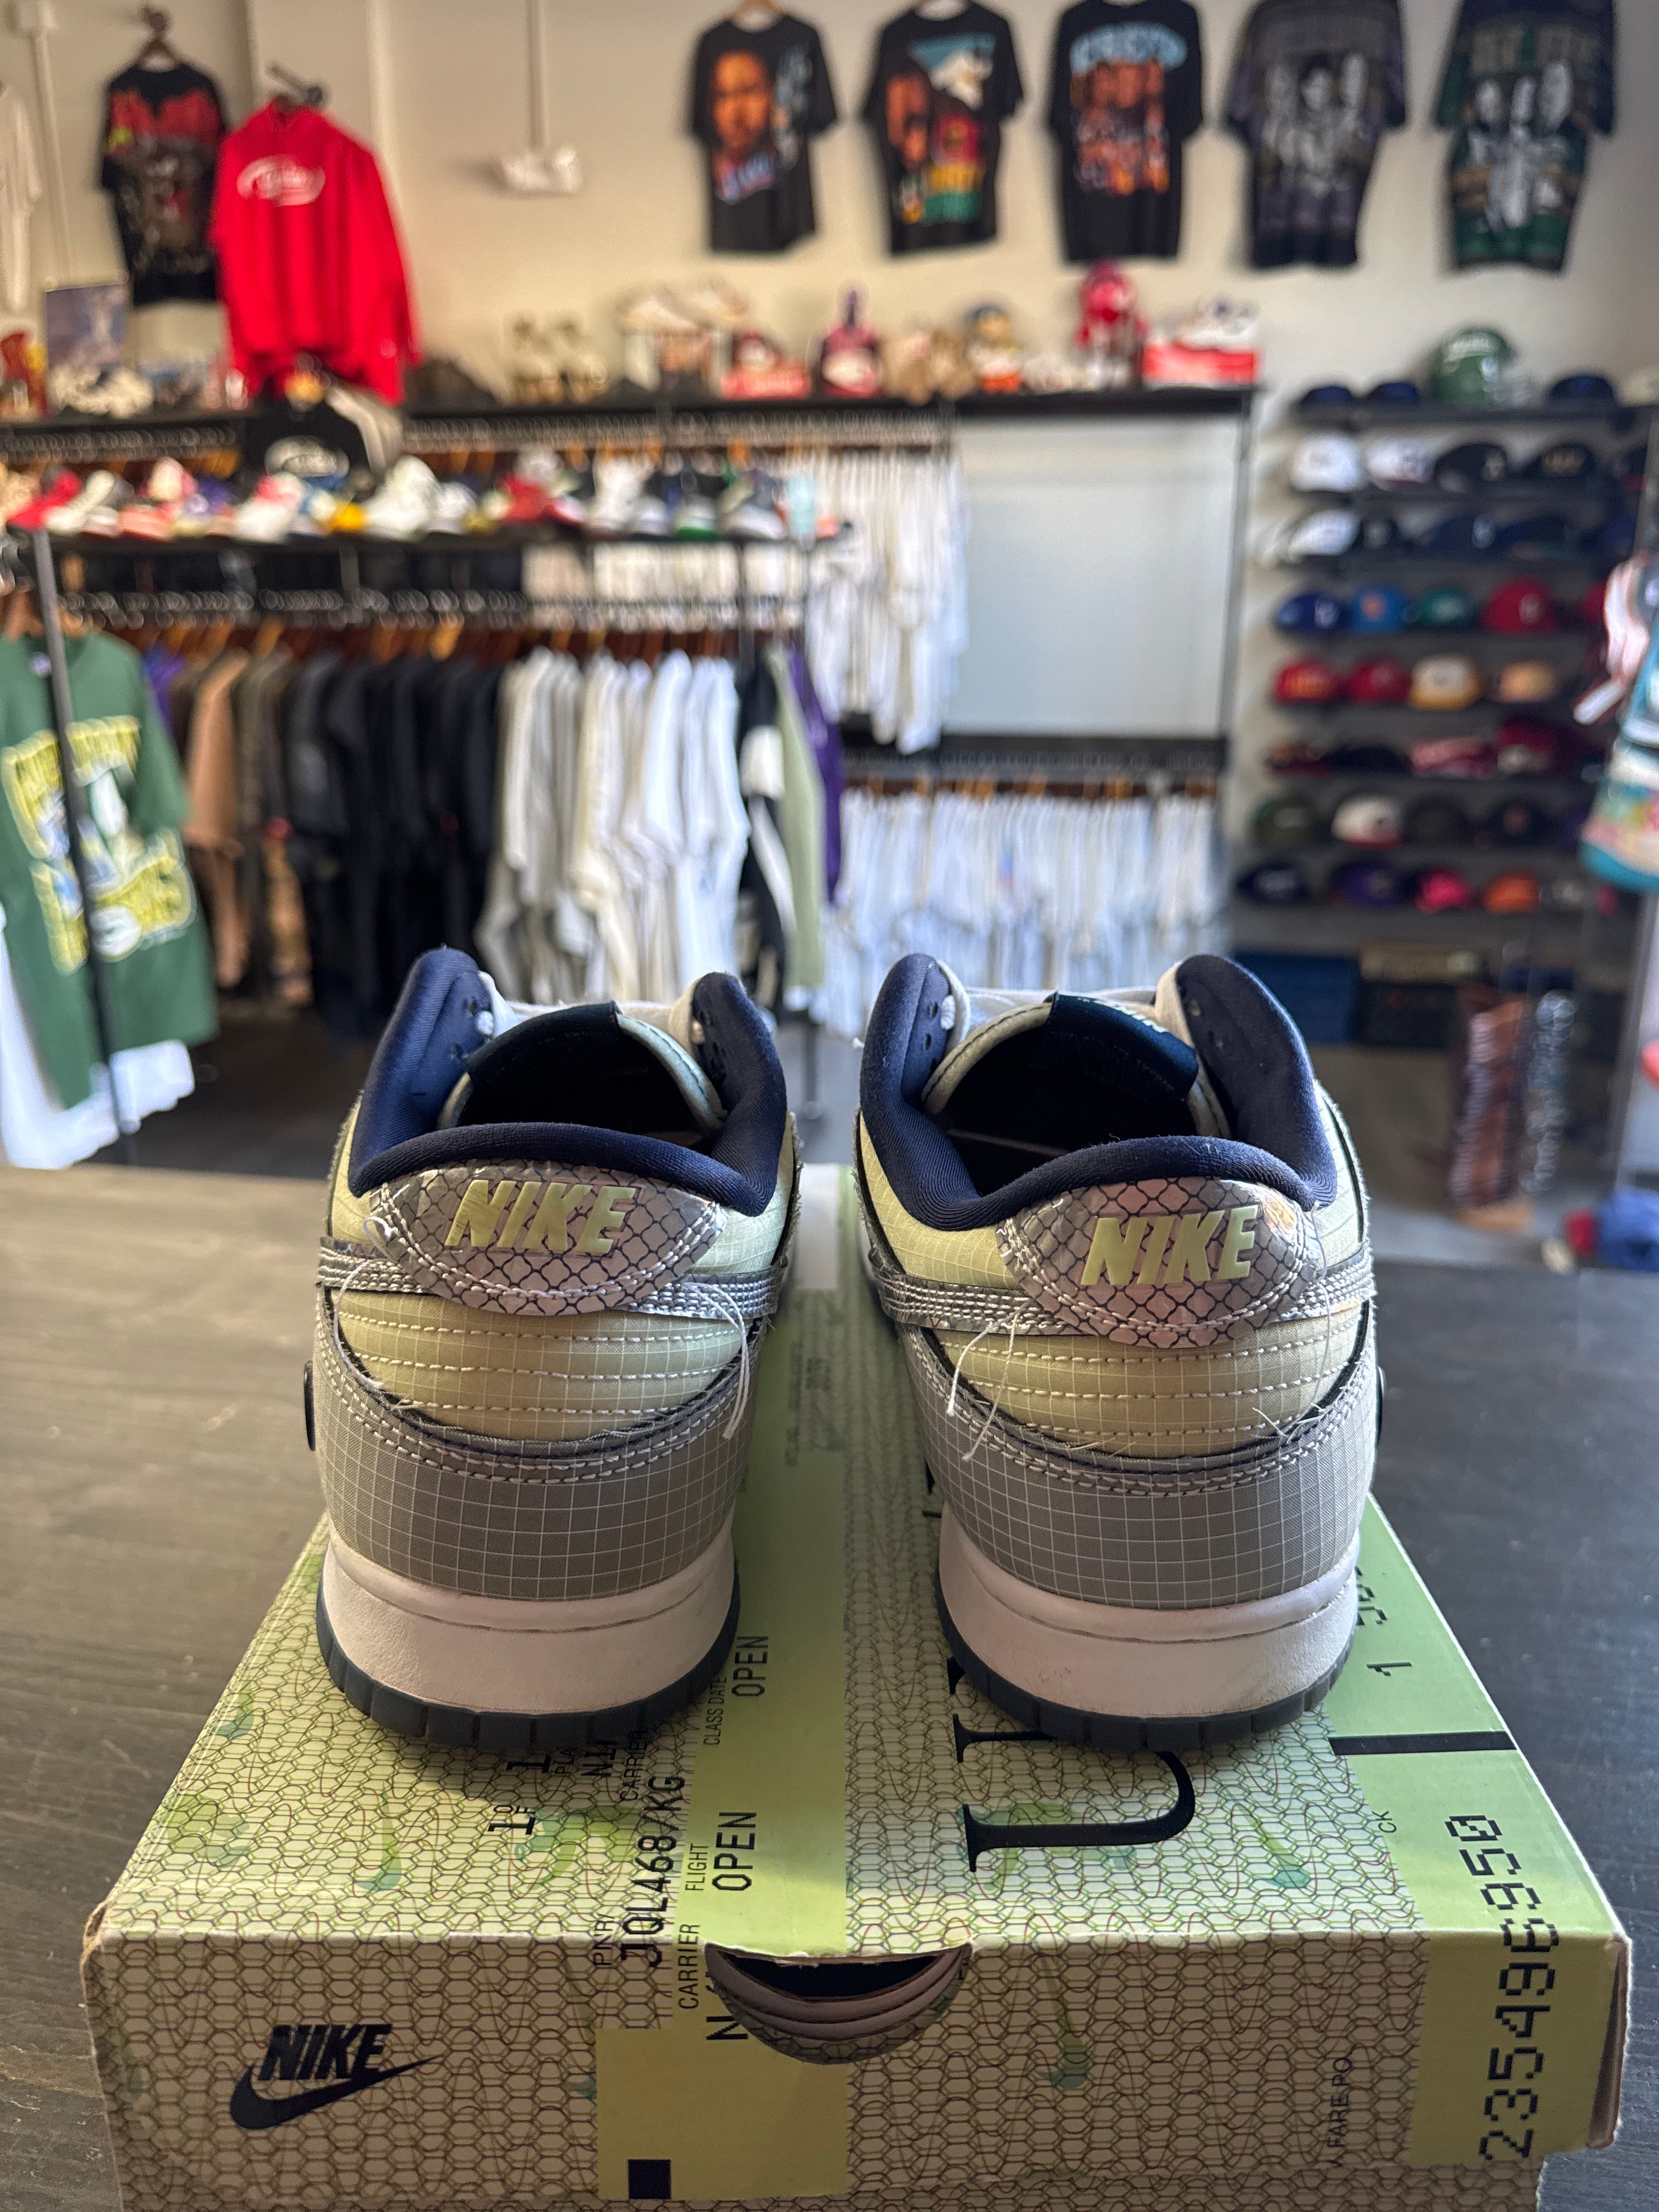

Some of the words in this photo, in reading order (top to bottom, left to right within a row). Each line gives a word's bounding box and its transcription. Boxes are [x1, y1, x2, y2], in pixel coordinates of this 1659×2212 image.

[444, 1180, 636, 1254] NIKE
[1081, 1205, 1258, 1285] NIKE
[731, 1635, 769, 1696] OPEN
[1366, 1661, 1412, 1677] 1
[703, 1708, 724, 1746] CLASS
[620, 1729, 648, 1801] CARRIER
[712, 1812, 757, 1891] OPEN
[1372, 1810, 1397, 1833] CK
[685, 1843, 709, 1891] FLIGHT
[678, 1923, 699, 2009] CARRIER
[1444, 1815, 1559, 2160] 235496950
[257, 2024, 393, 2081] NIKE
[1327, 2094, 1349, 2147] FARE
